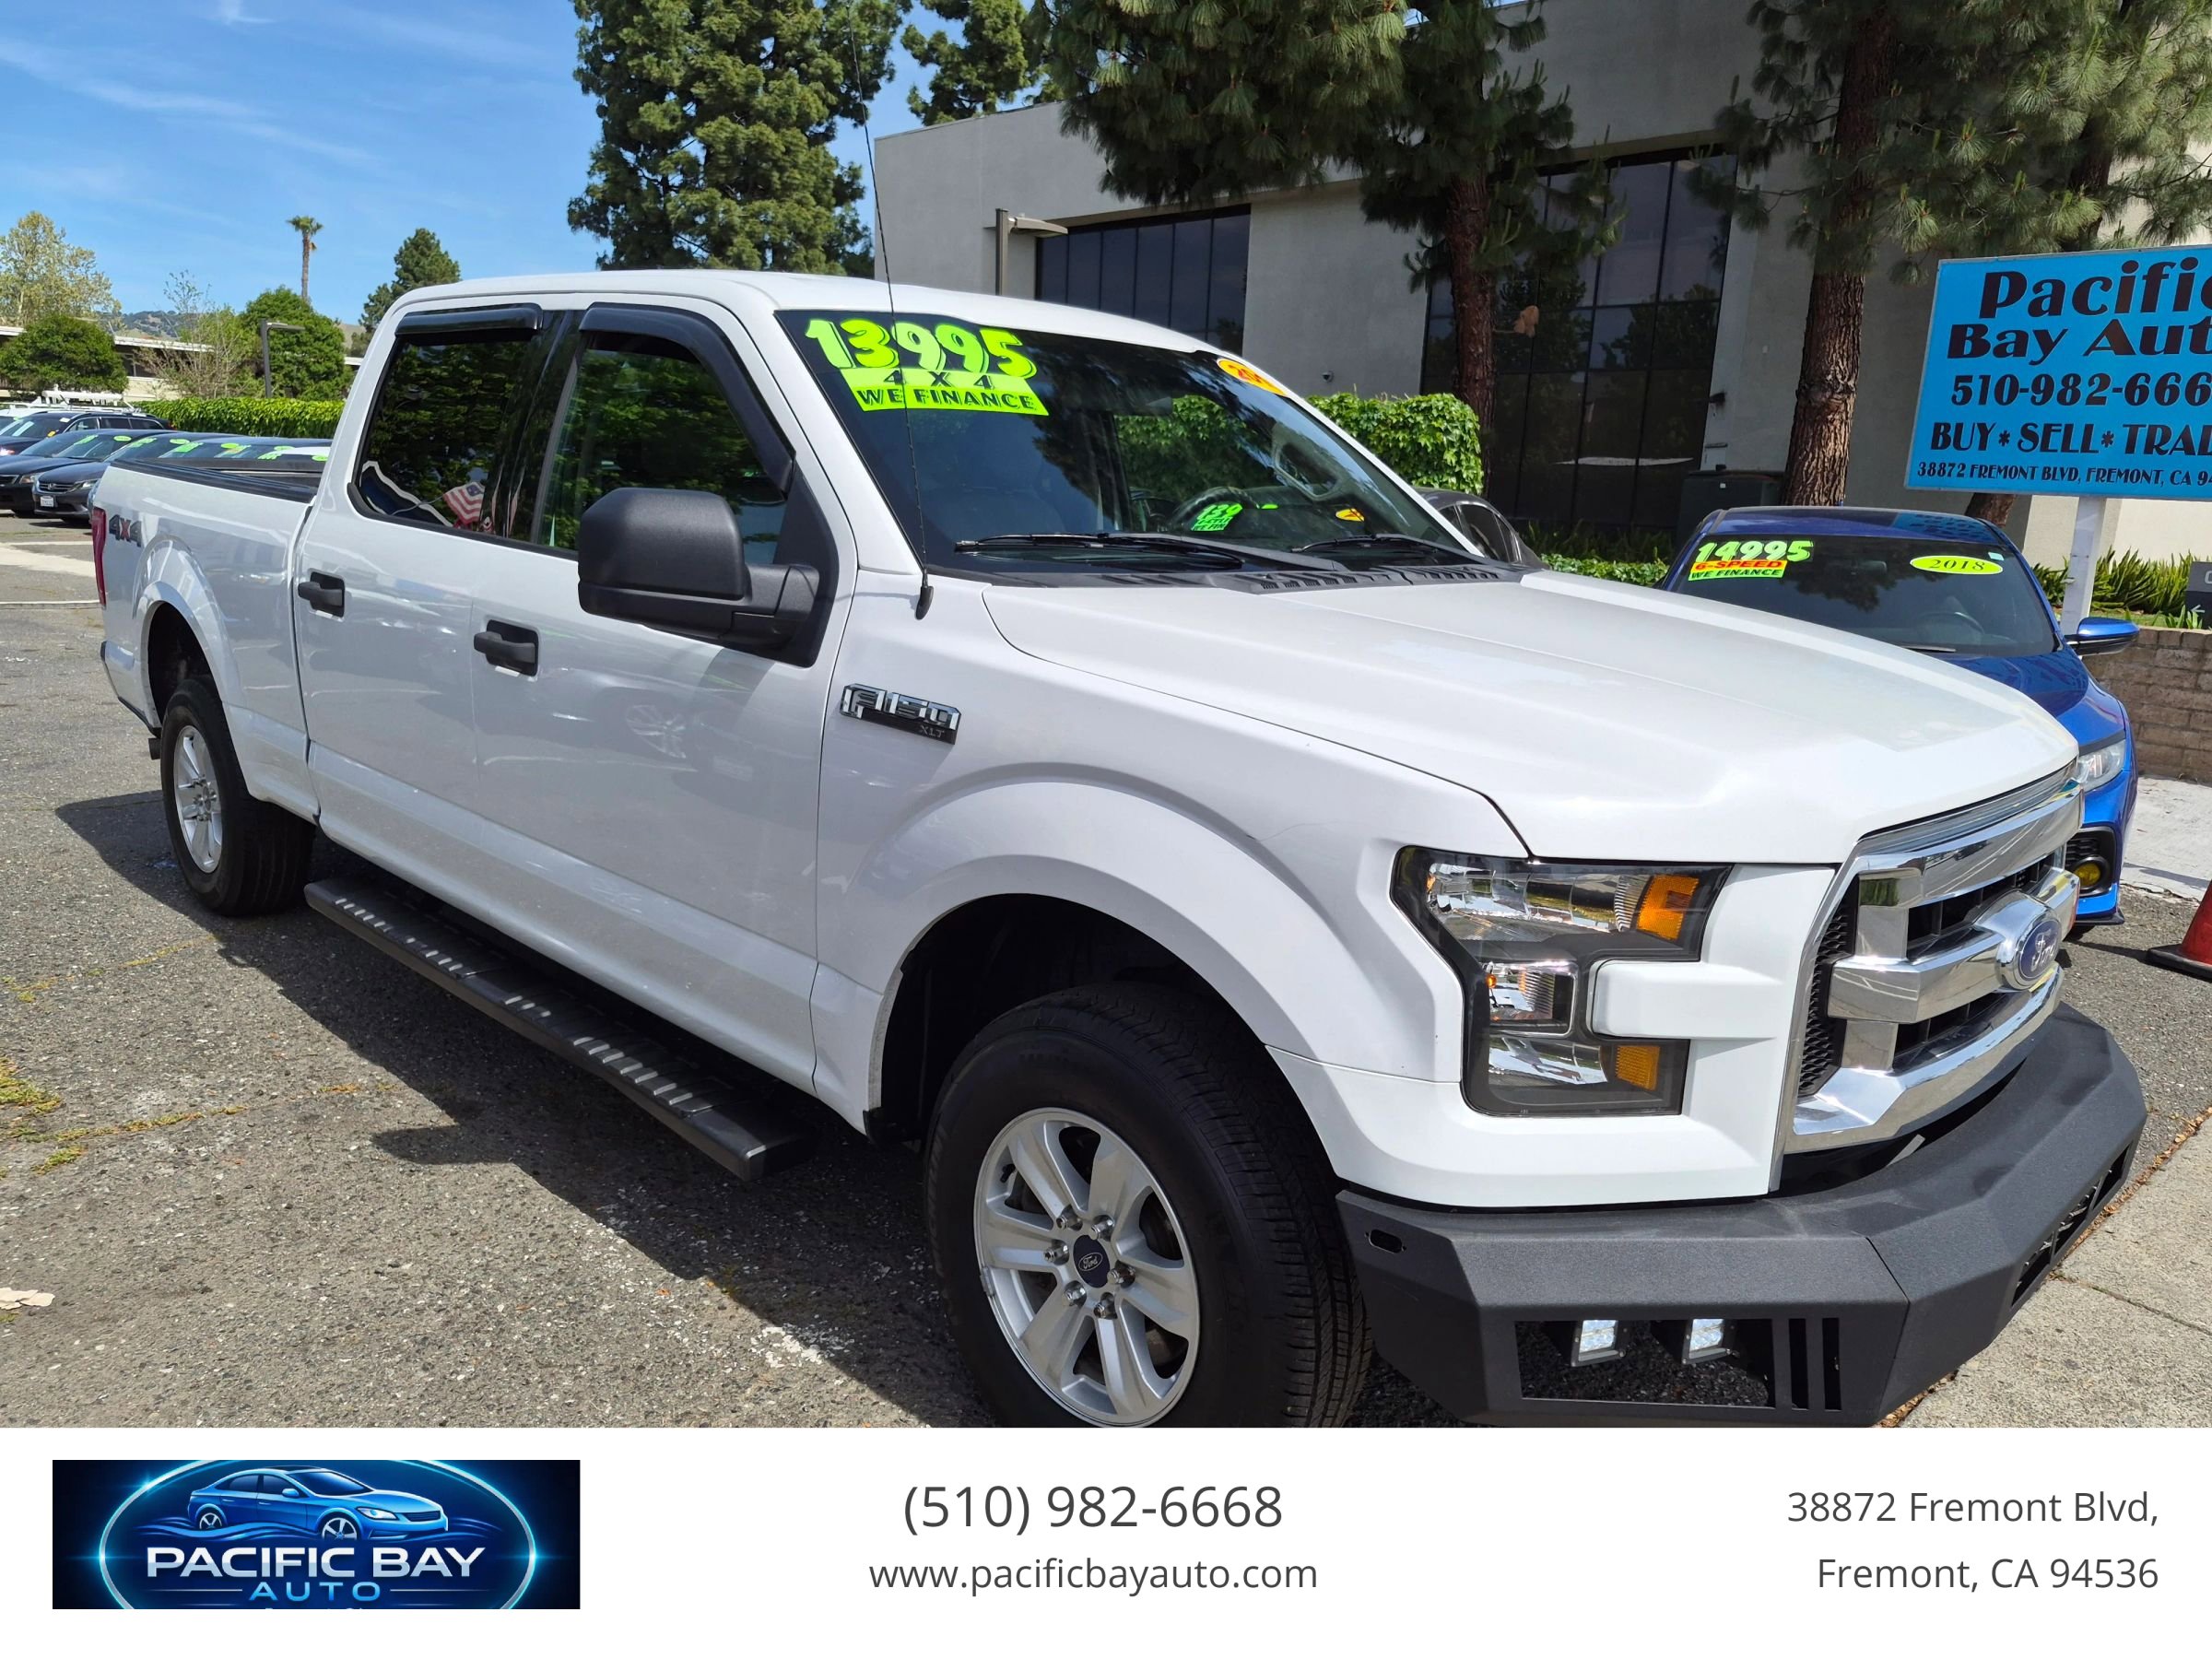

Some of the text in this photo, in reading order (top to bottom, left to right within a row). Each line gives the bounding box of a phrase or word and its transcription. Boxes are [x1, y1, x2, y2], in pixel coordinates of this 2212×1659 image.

[1979, 257, 2212, 319] Pacifi
[805, 319, 1038, 379] 13995
[1947, 324, 2068, 366] Bay
[856, 388, 1036, 410] WE FINANCE
[1918, 462, 1966, 477] 38872
[1970, 464, 2039, 480] FREMONT
[2041, 465, 2081, 485] BLVD,
[2086, 467, 2164, 488] FREMONT,
[2170, 470, 2192, 486] CA
[1696, 540, 1814, 563] 14995
[1691, 569, 1782, 580] WE FINANCE
[1695, 560, 1783, 571] 6-SPEED
[1929, 559, 1985, 571] 2018
[920, 724, 945, 738] XLT
